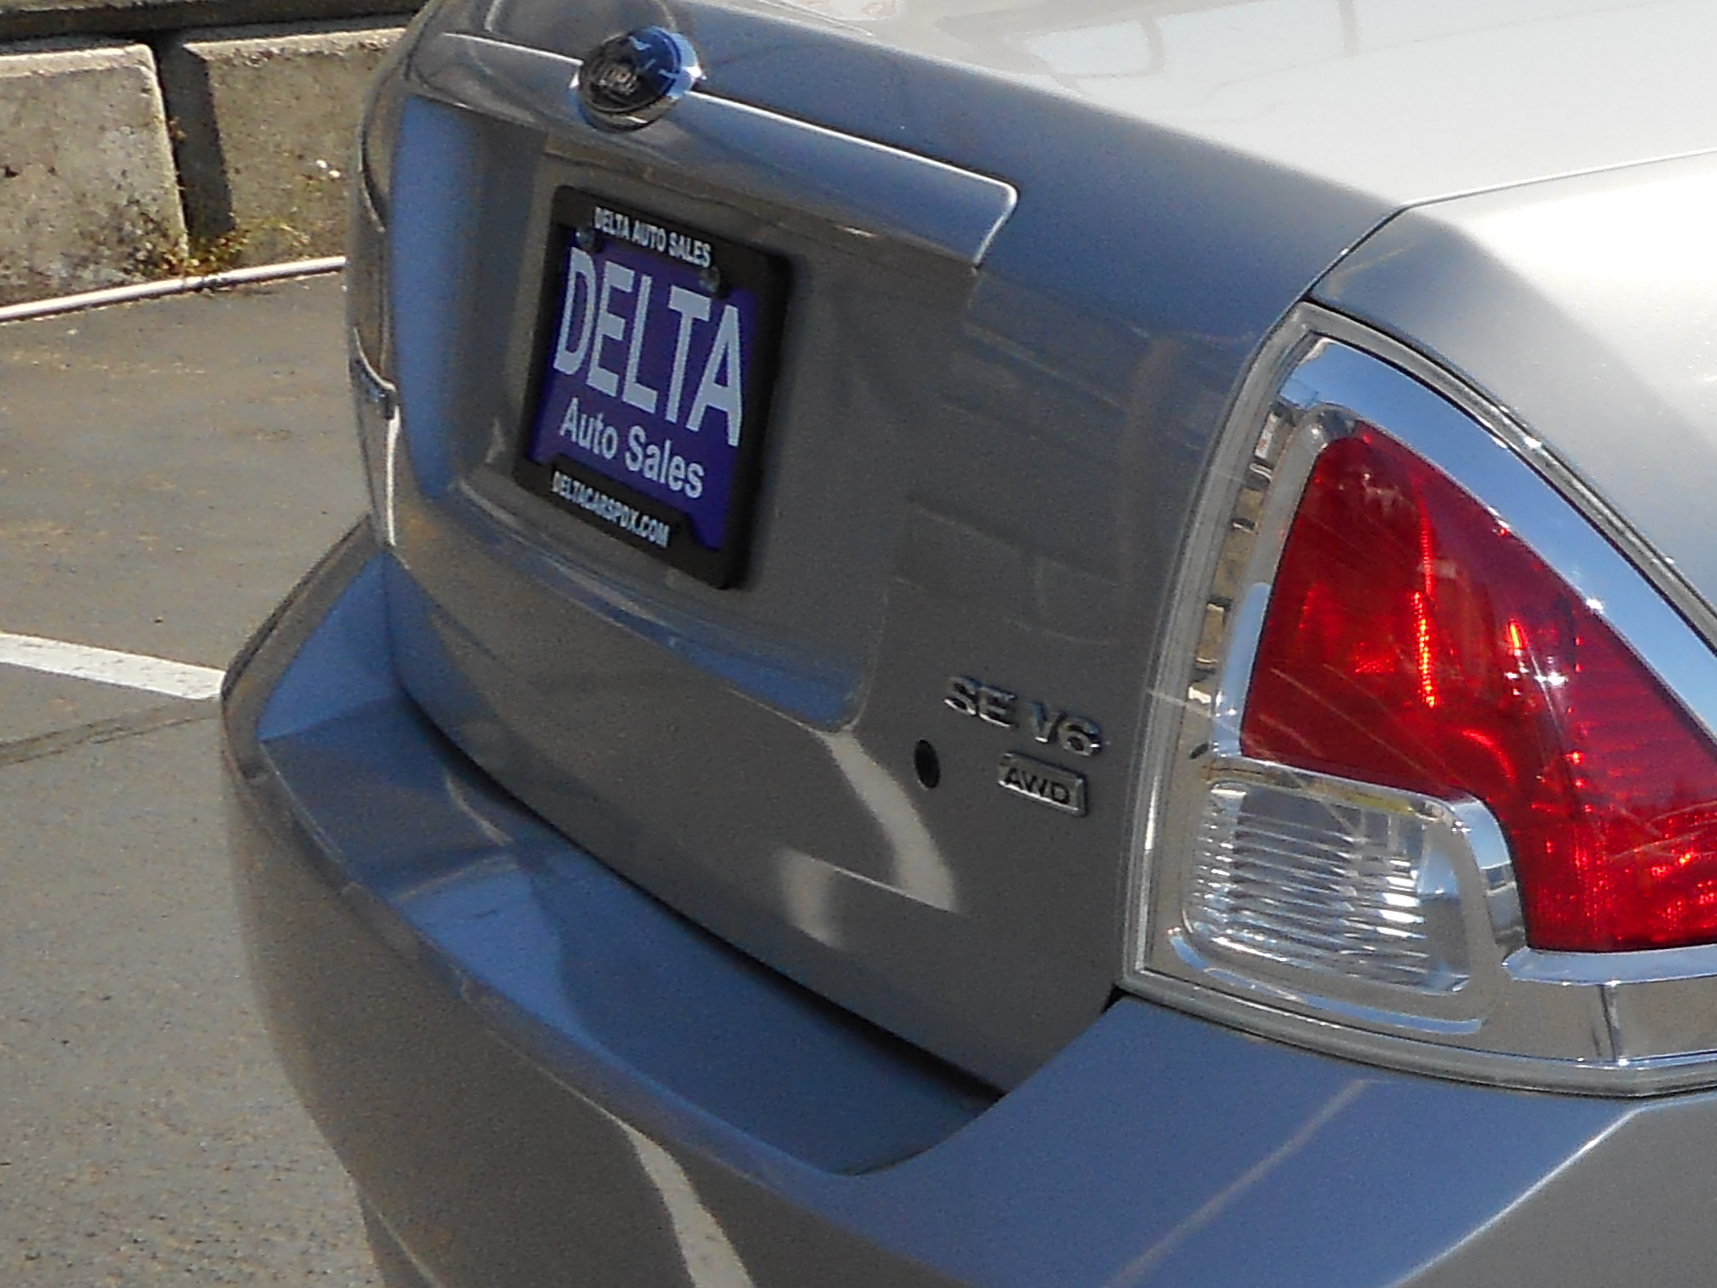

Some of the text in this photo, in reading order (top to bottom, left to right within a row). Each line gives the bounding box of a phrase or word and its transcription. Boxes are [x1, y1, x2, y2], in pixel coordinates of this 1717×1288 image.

[594, 206, 711, 268] DELTA AUTO SALES
[552, 246, 743, 448] DELTA
[560, 397, 704, 499] Auto Sales
[944, 675, 1102, 756] SE V6
[1004, 766, 1070, 806] AWD
